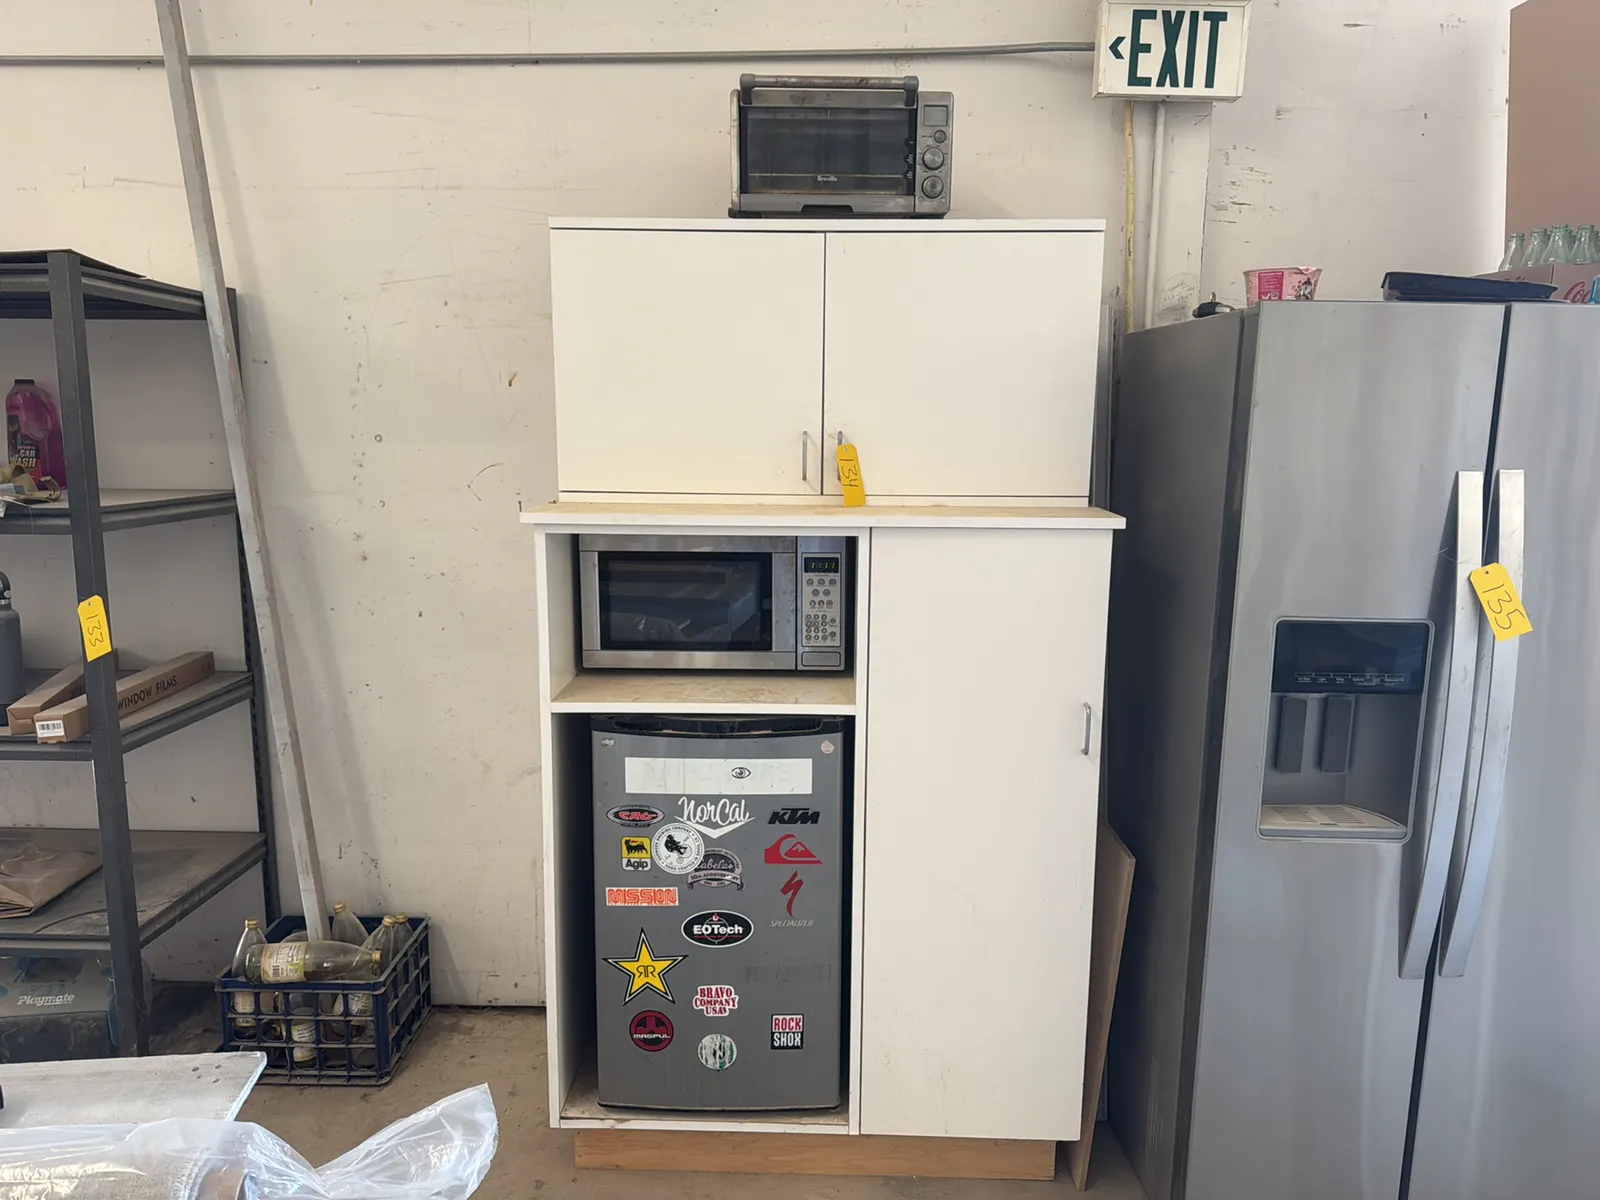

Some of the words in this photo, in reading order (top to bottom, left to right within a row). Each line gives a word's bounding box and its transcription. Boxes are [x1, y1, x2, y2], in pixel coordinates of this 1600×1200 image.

[1127, 9, 1228, 89] EXIT
[19, 449, 36, 458] CAR
[839, 458, 859, 487] 134
[1482, 583, 1525, 630] 135
[85, 613, 105, 647] 133
[118, 686, 153, 710] WINDOW
[156, 675, 178, 695] FILMS
[678, 796, 749, 826] NorCal
[768, 808, 820, 824] KTM
[625, 859, 649, 870] Agip
[703, 872, 739, 881] ANNIVERRY
[608, 888, 677, 905] MISSION
[693, 924, 743, 934] EOTech
[769, 920, 815, 928] SPECIALIZED
[700, 986, 733, 998] BRAVO
[17, 993, 74, 1006] Playmate
[694, 997, 737, 1008] COMPANY
[774, 1017, 802, 1031] ROCK
[774, 1032, 801, 1047] SHOX
